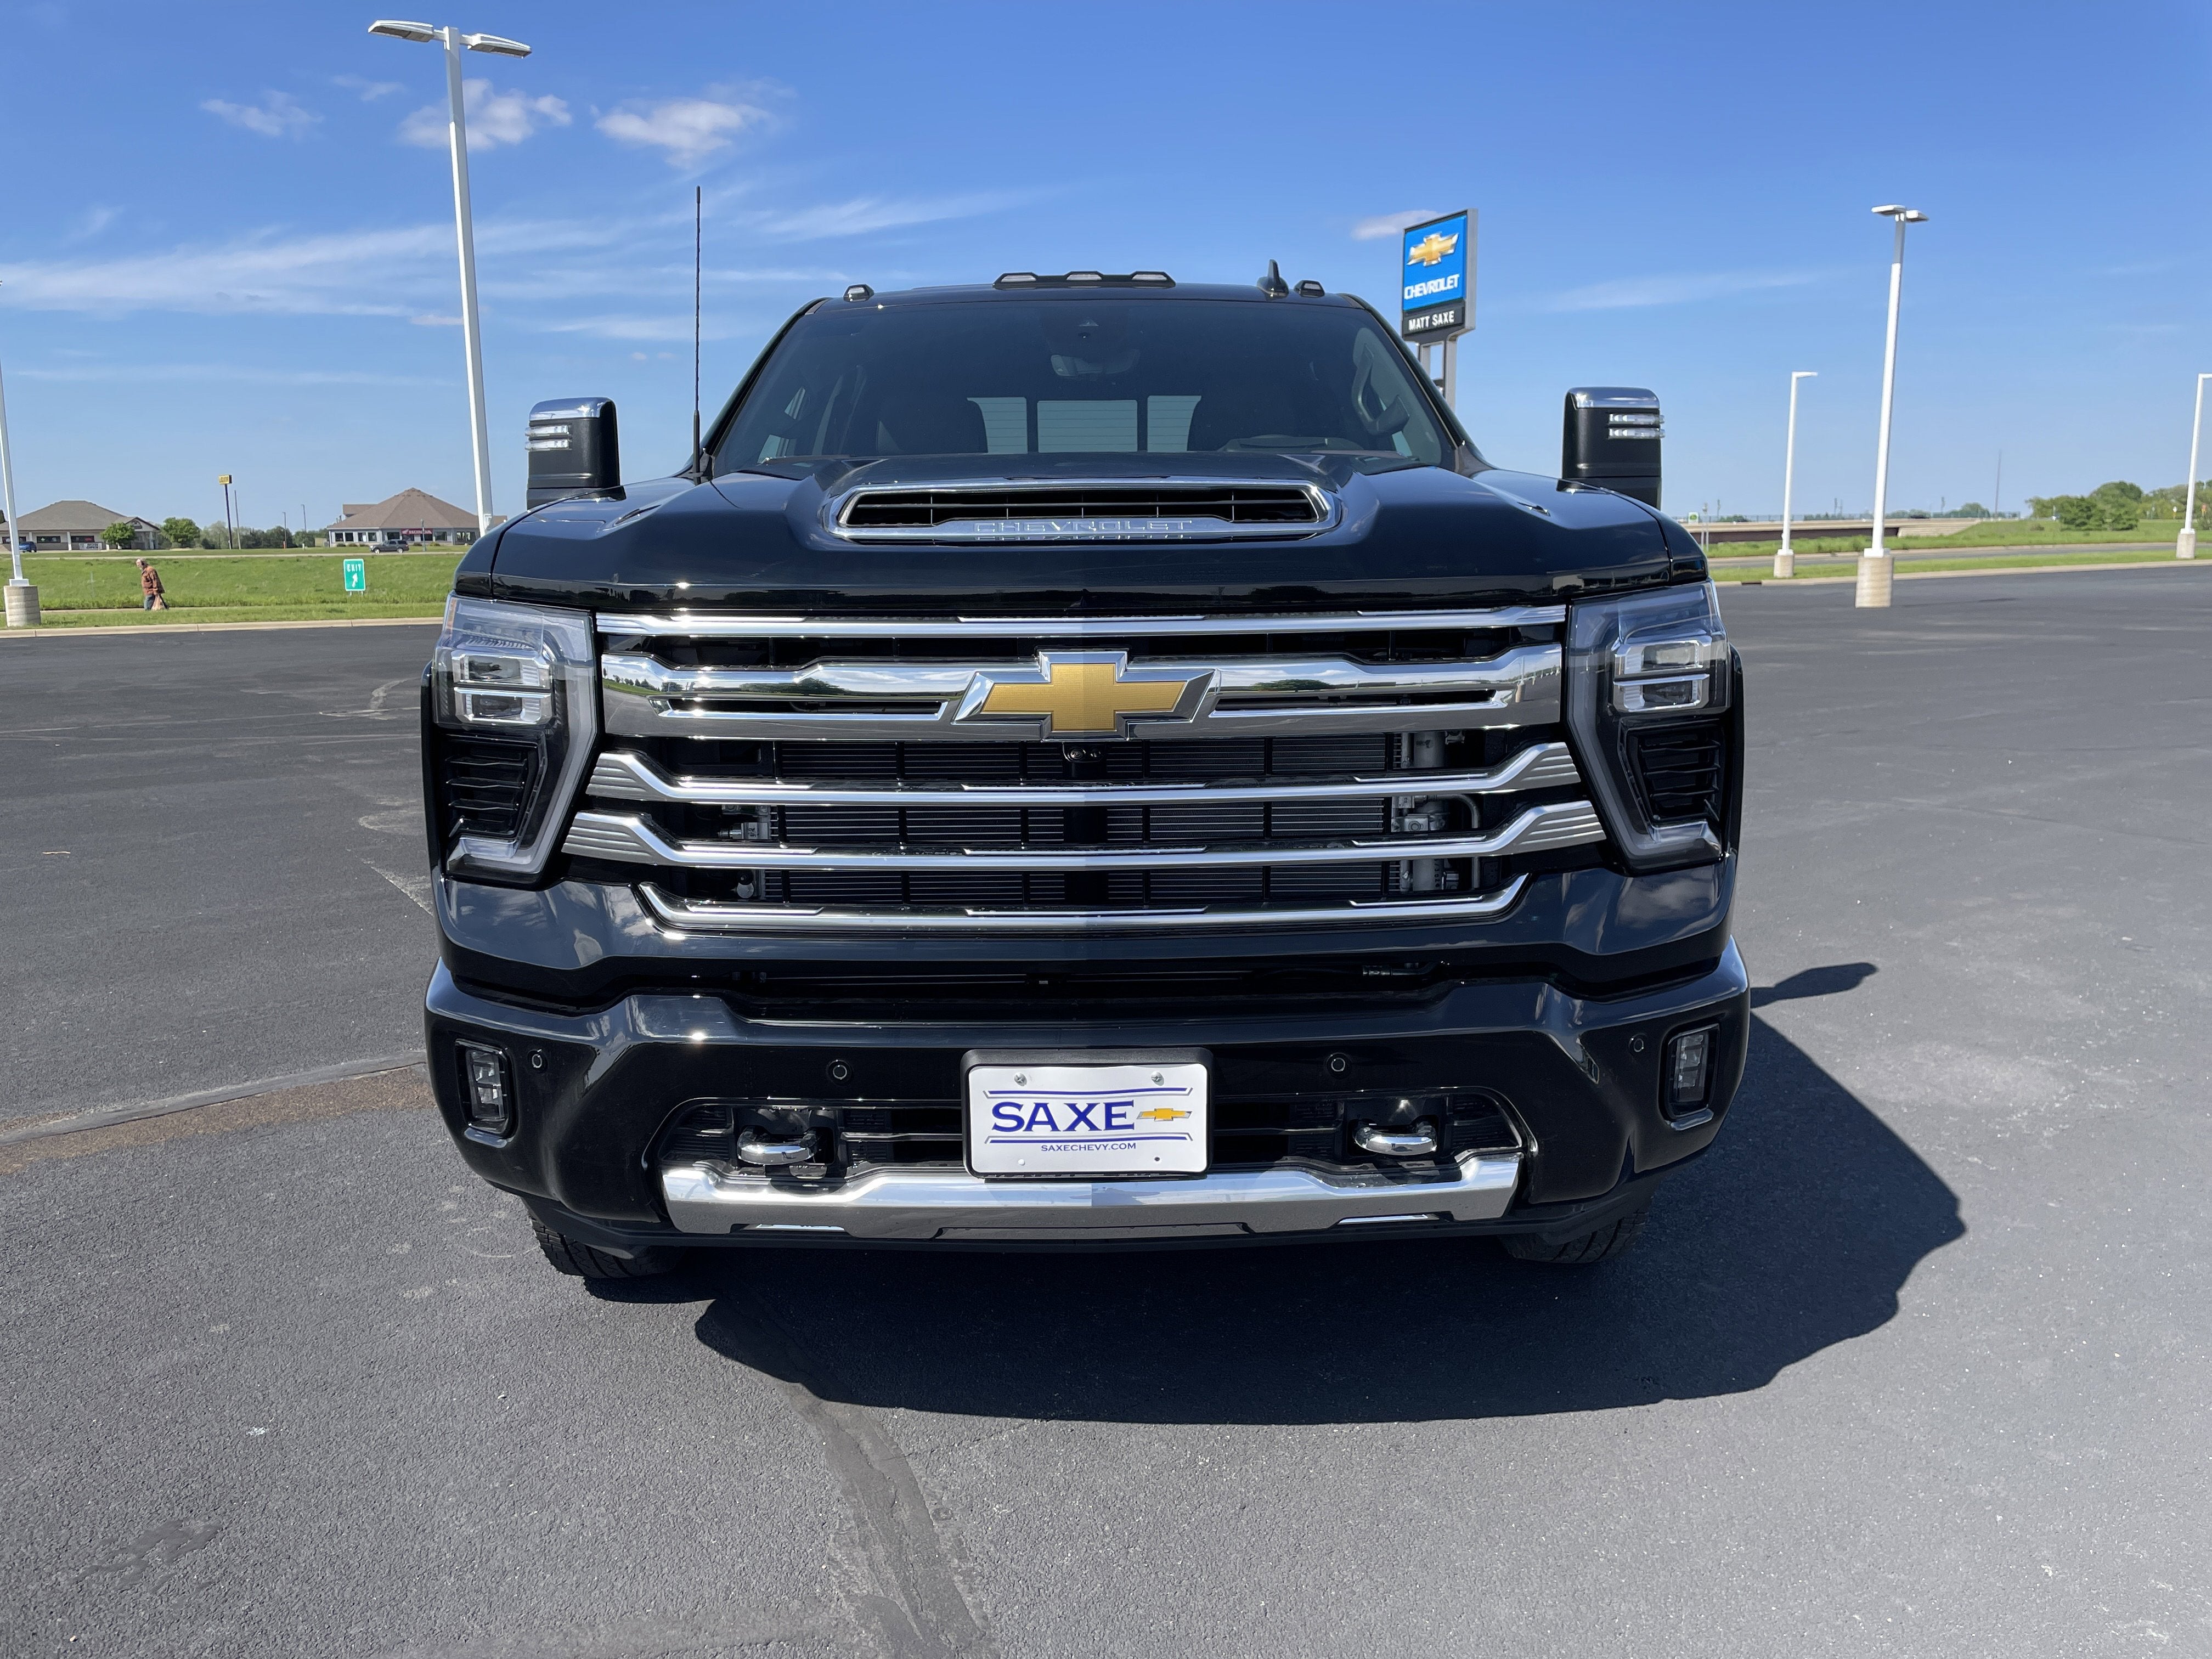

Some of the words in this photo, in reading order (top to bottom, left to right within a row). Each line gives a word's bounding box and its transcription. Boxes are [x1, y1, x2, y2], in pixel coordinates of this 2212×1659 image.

[1403, 274, 1460, 300] CHEVROLET
[1408, 315, 1430, 331] MATT
[1432, 311, 1455, 327] SAXE
[974, 520, 1192, 533] CHEVROLET
[347, 563, 362, 572] EXIT
[992, 1099, 1135, 1133] SAXE
[1041, 1142, 1136, 1152] SAXECHEVY.COM
